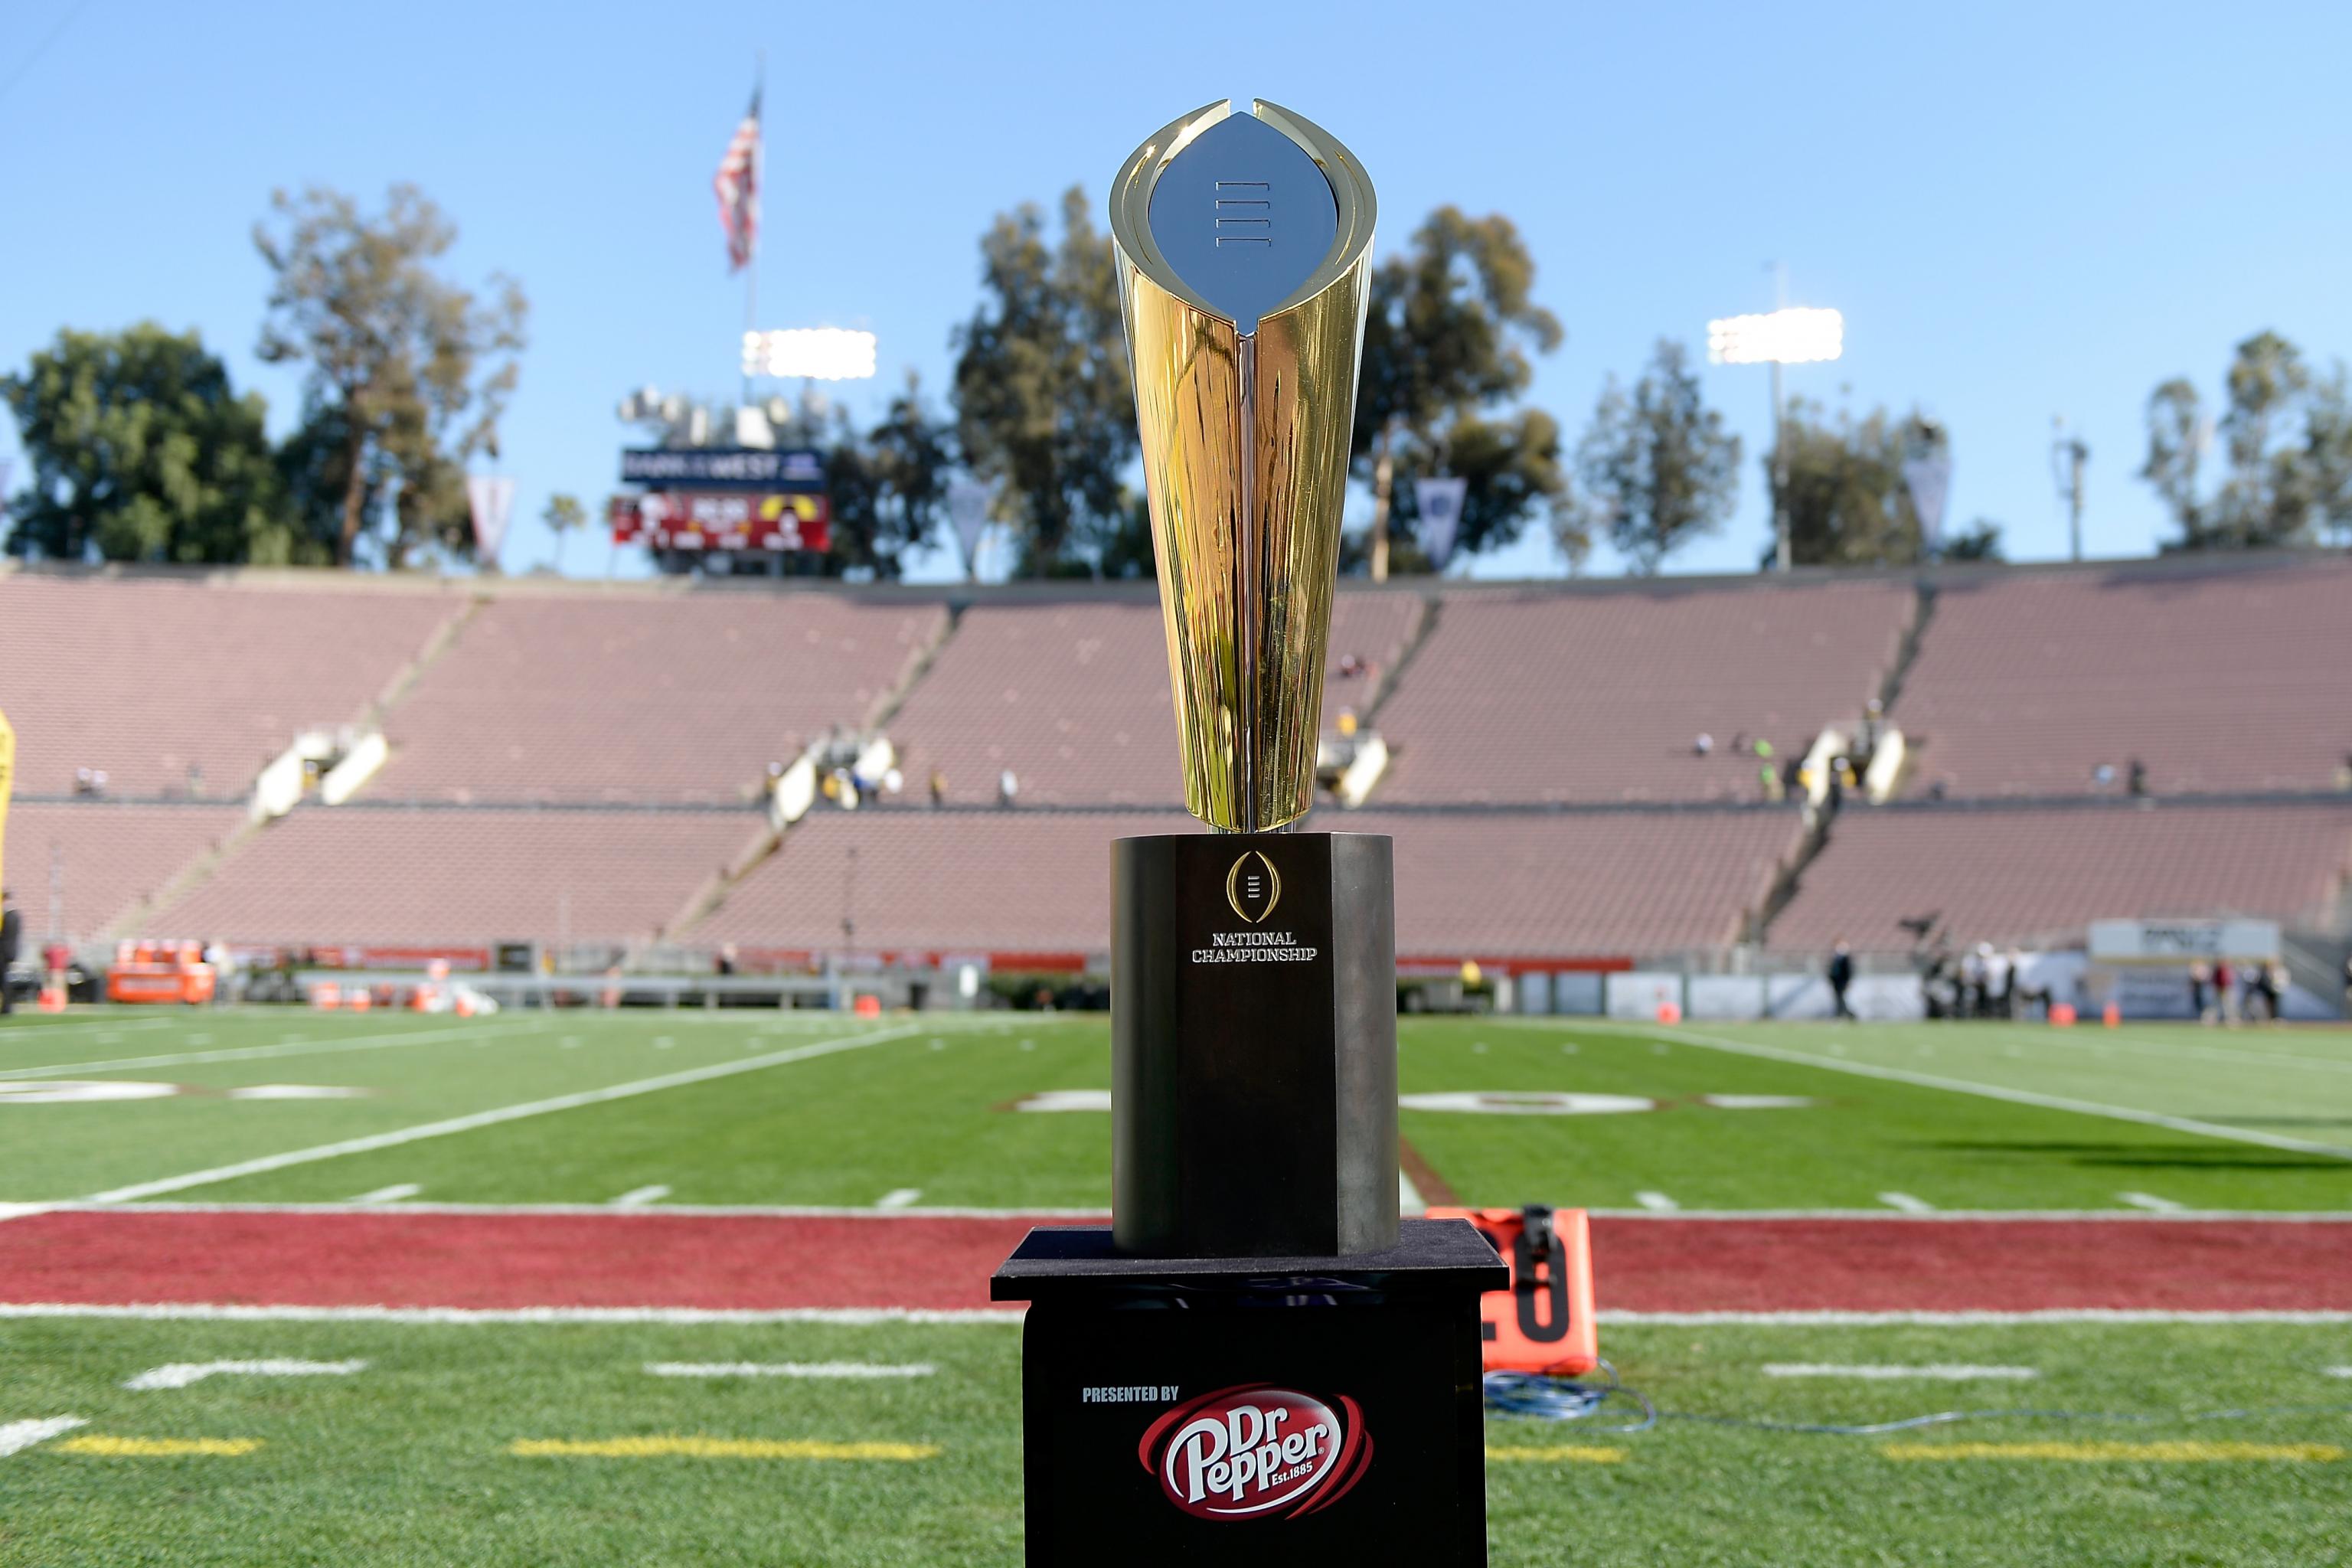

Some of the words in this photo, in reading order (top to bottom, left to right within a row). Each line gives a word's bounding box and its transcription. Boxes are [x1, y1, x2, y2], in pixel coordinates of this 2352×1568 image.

[1212, 931, 1297, 946] NATIONAL
[1191, 947, 1318, 963] CHAMPIONSHIP
[1083, 1386, 1158, 1403] PRESENTED
[1161, 1385, 1179, 1401] BY
[1226, 1405, 1288, 1456] Dr
[1166, 1418, 1328, 1504] Pepper
